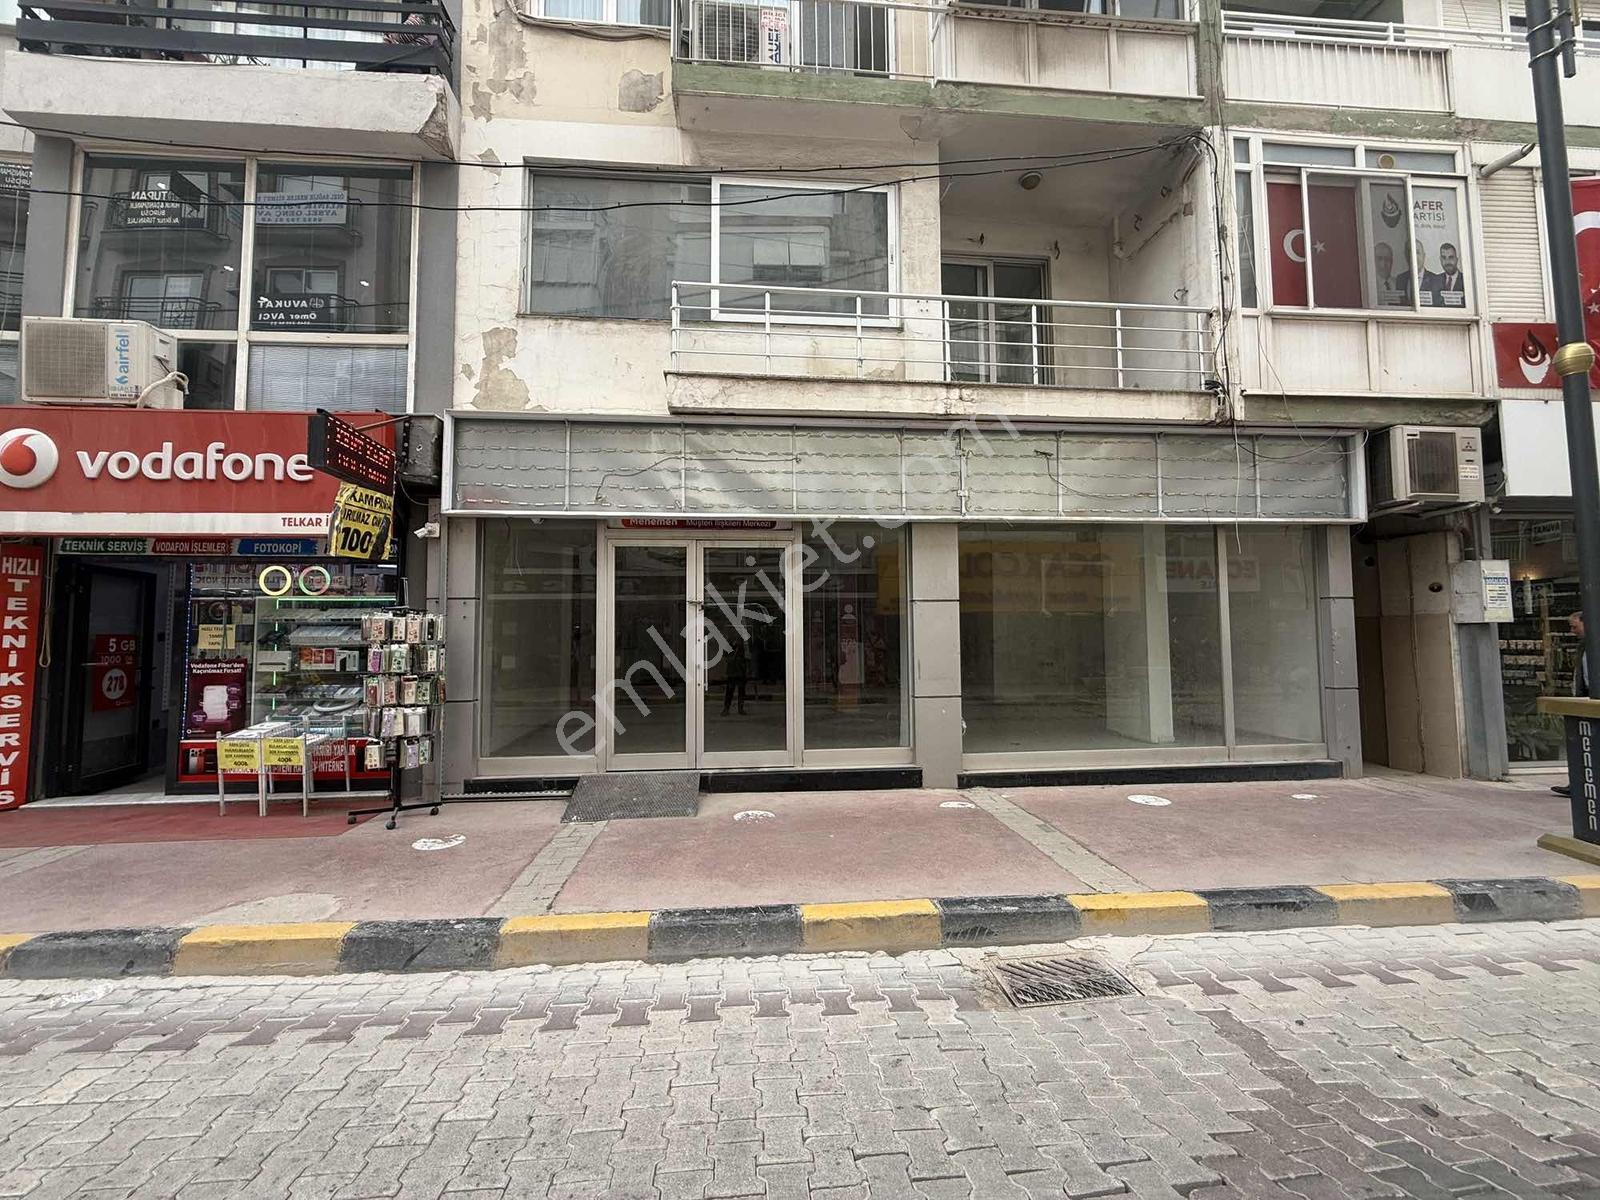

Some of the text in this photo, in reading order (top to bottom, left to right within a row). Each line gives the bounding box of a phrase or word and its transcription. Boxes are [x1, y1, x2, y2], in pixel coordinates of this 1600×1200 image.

[1414, 200, 1444, 210] AFER
[1414, 211, 1445, 221] ARTİSİ
[116, 335, 129, 374] airfel
[76, 442, 314, 482] vodafone
[282, 517, 322, 527] TELKAR
[64, 539, 144, 552] TEKNİK SERVİS
[155, 540, 227, 553] VODAFON İŞLEMLER
[340, 527, 372, 553] 100
[254, 542, 302, 553] FOTOKOPİ
[2, 557, 39, 576] HIZLI
[0, 578, 30, 687] TEKNİK
[109, 638, 136, 652] 5 GB
[0, 694, 22, 806] SERVİS
